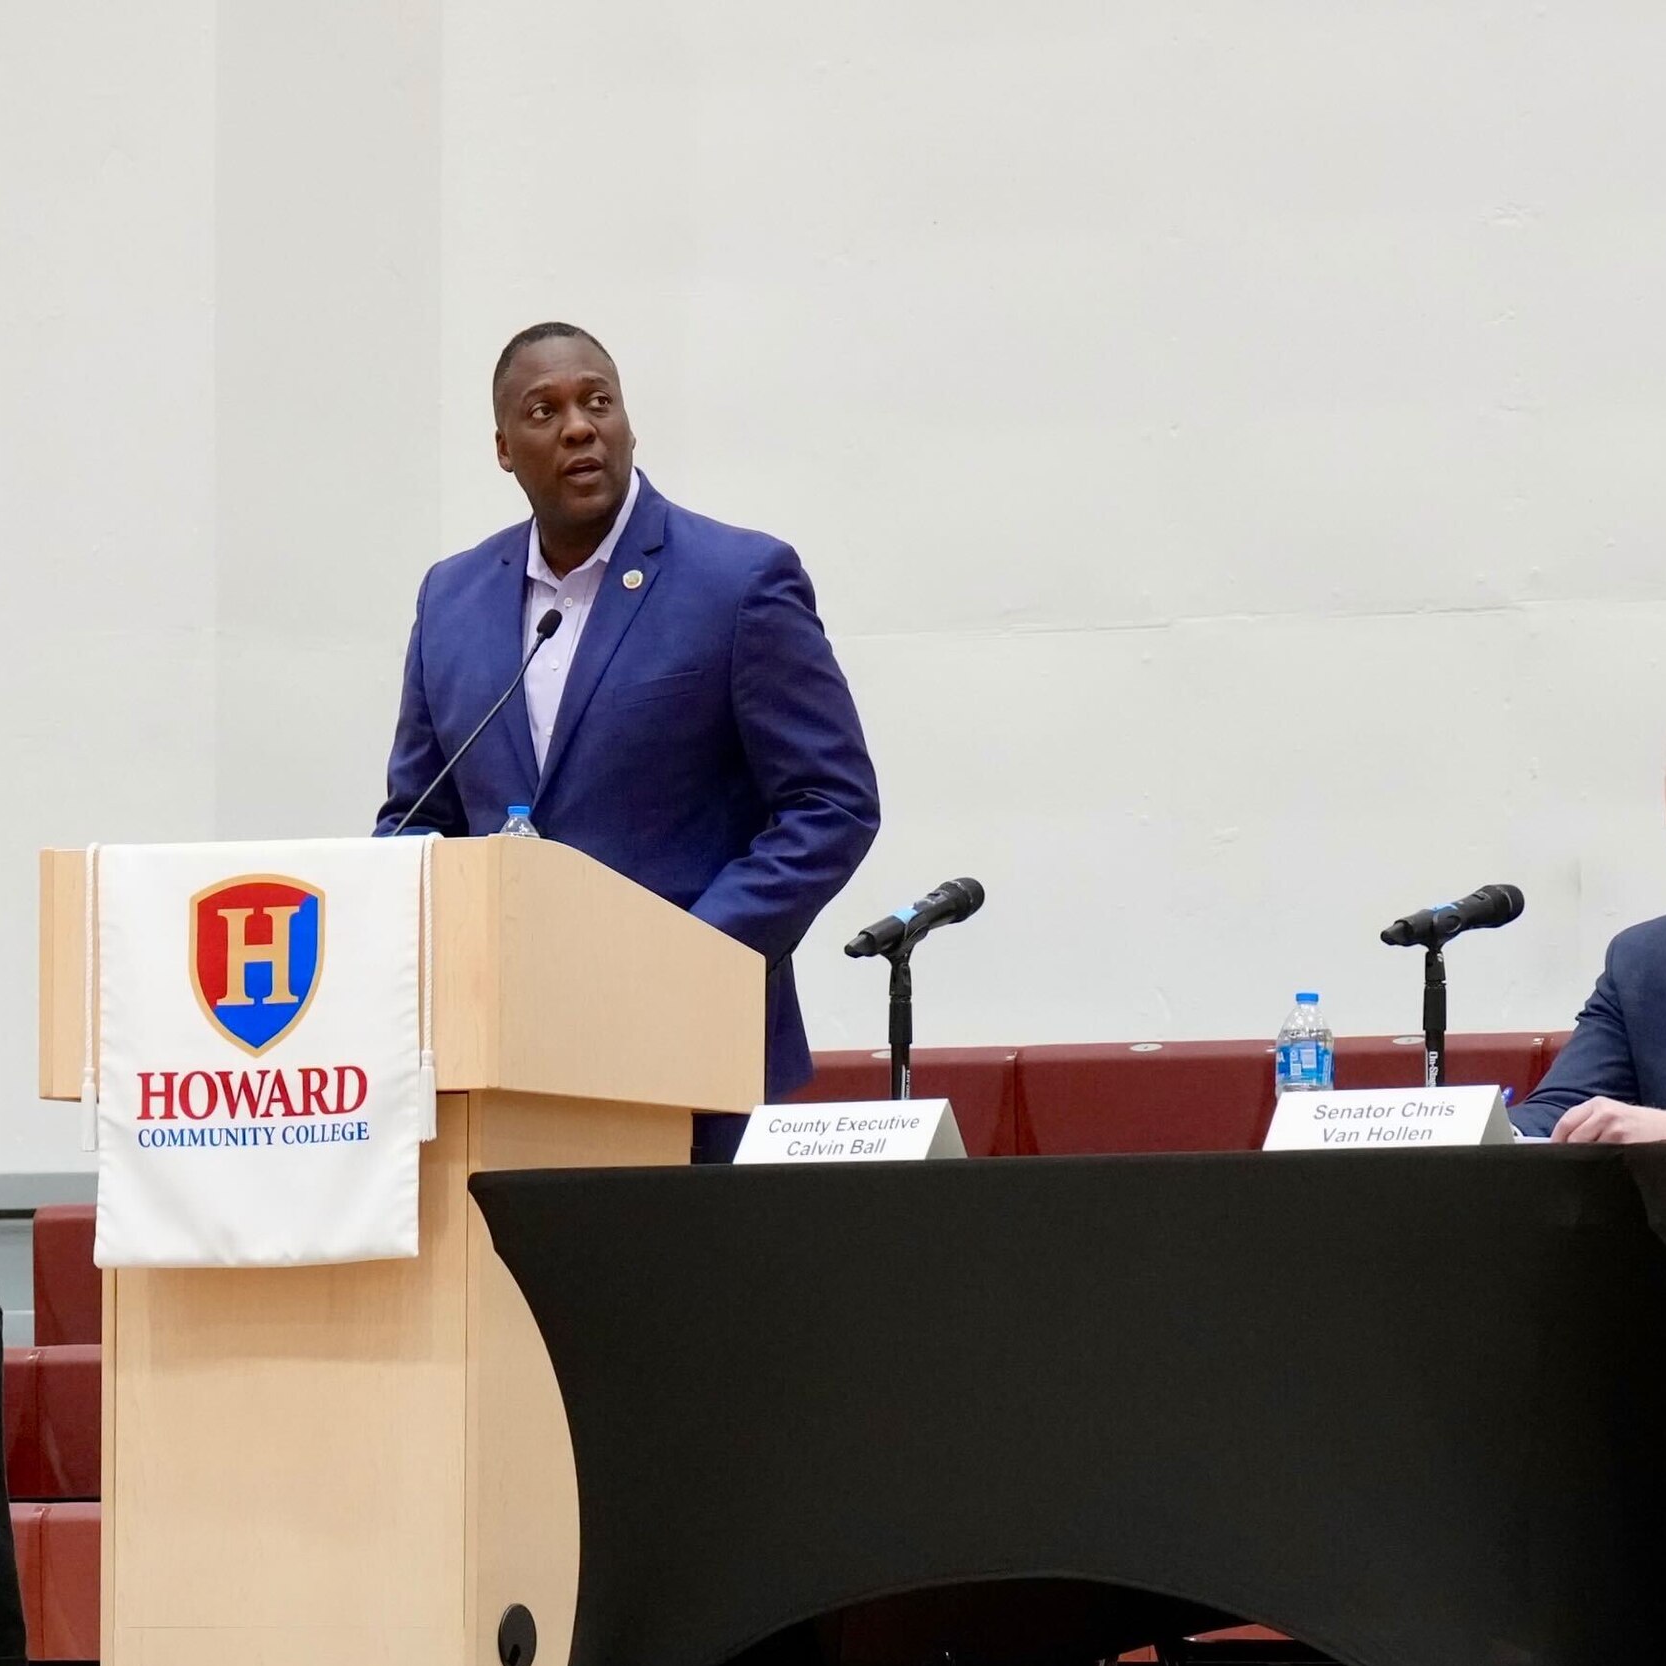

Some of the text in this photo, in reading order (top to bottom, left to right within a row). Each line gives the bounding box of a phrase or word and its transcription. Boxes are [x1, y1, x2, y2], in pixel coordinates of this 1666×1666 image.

[216, 905, 301, 1007] H
[136, 1065, 368, 1121] HOWARD
[1313, 1101, 1455, 1120] Senator Chris
[137, 1121, 370, 1148] COMMUNITY COLLEGE
[768, 1115, 920, 1136] County Executive
[1323, 1126, 1433, 1143] Van Hollen
[786, 1138, 887, 1156] Calvin Ball
